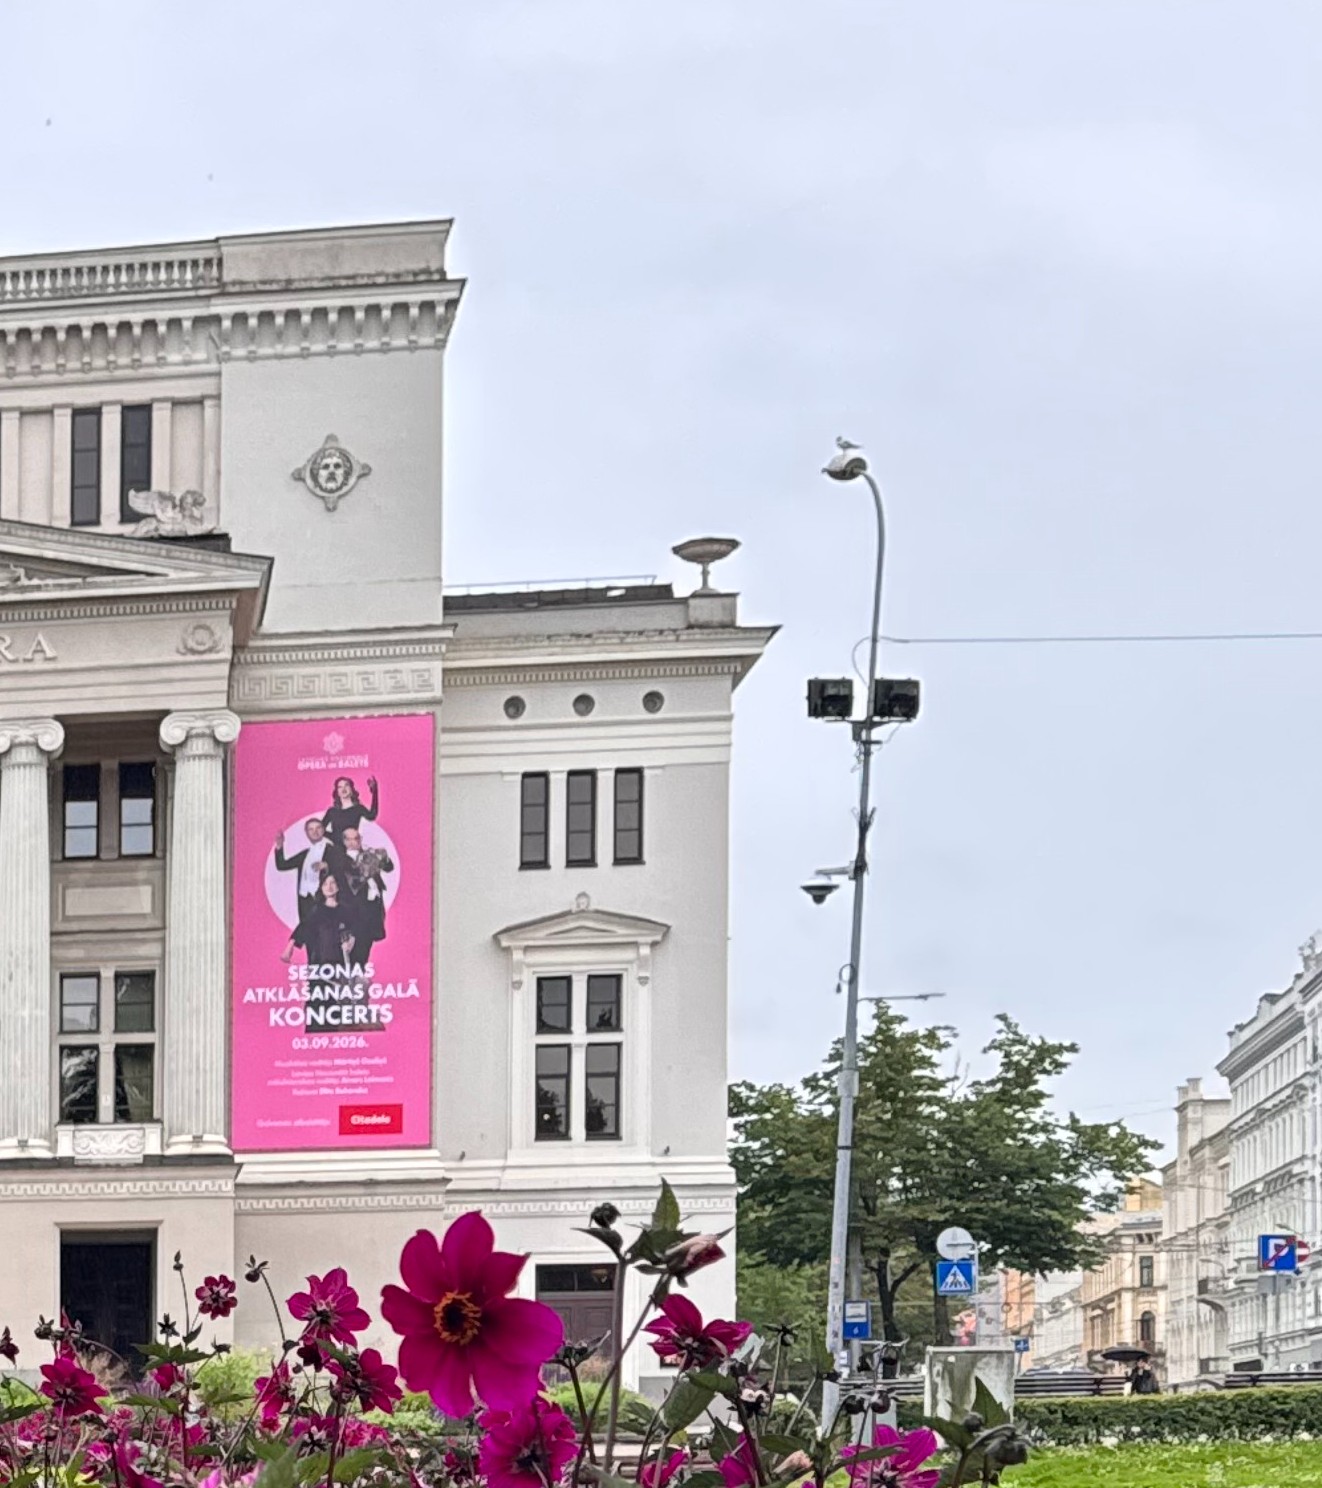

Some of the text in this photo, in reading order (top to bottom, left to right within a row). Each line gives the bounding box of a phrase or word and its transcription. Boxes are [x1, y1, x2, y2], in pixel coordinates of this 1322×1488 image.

[288, 962, 375, 981] SEZONAS
[243, 979, 420, 1004] ATKLĀŠANAS GALĀ
[269, 1003, 393, 1027] KONCERTS
[350, 1114, 391, 1125] Citadele
